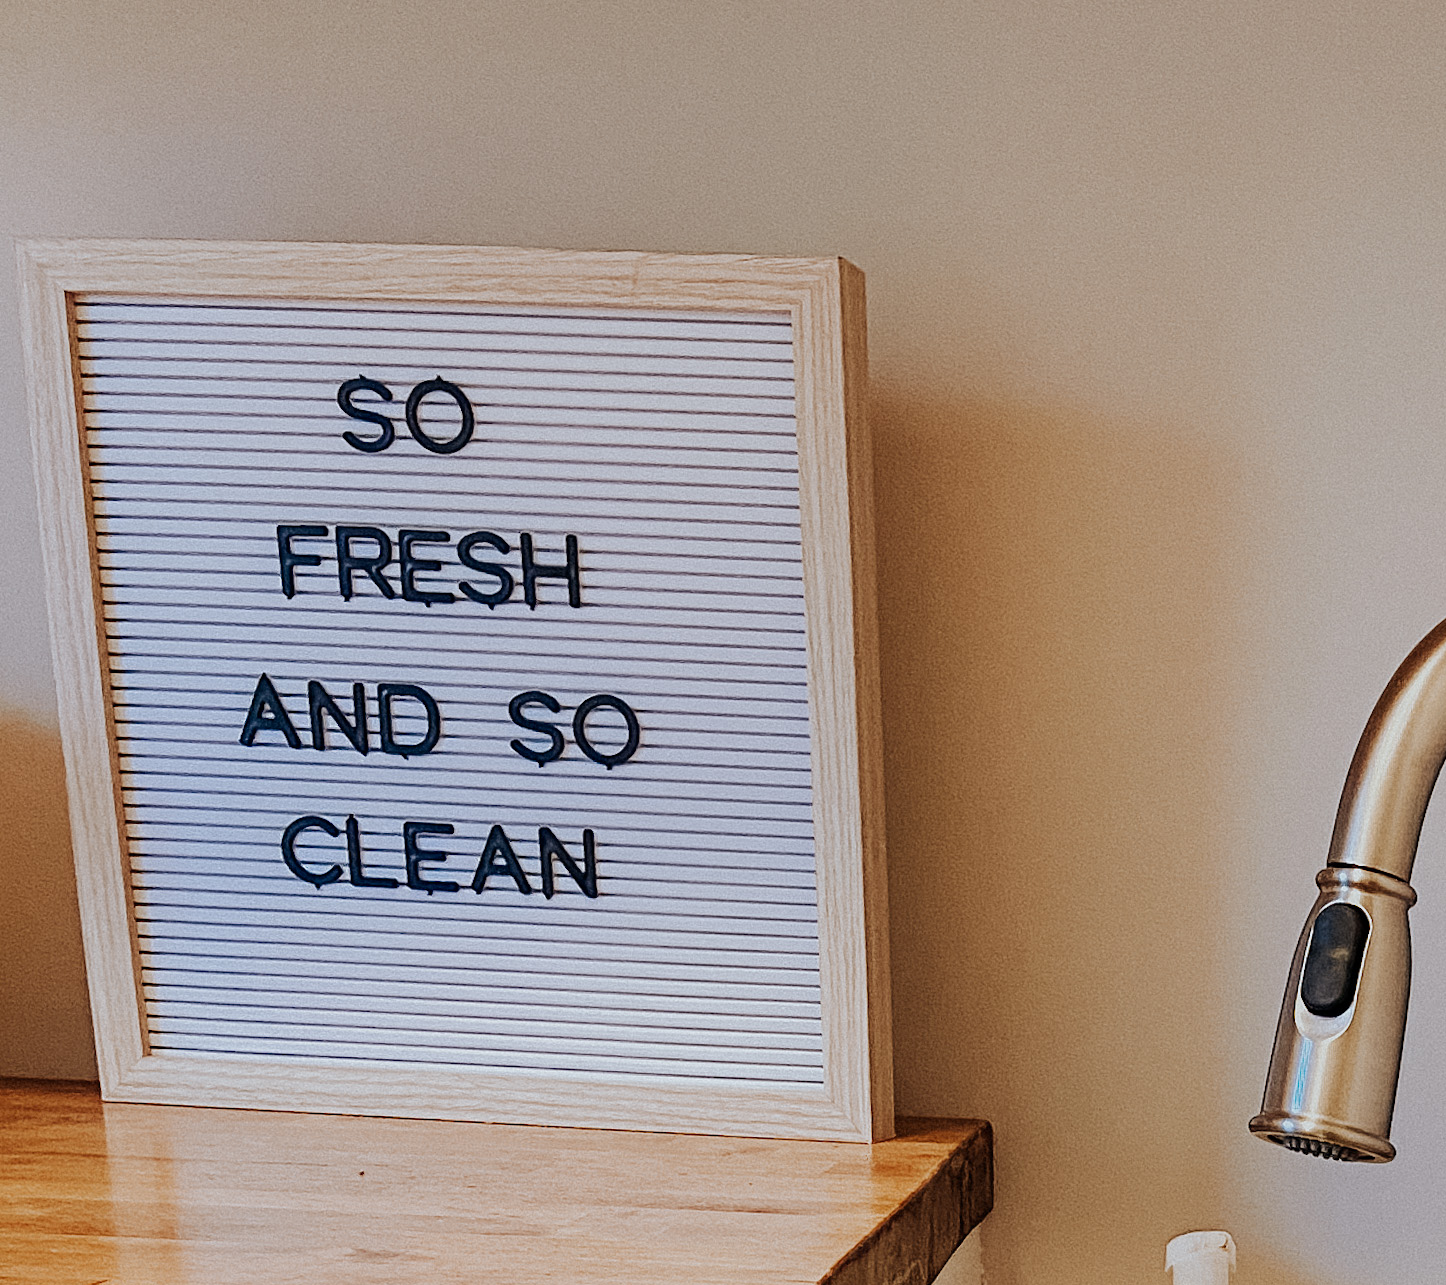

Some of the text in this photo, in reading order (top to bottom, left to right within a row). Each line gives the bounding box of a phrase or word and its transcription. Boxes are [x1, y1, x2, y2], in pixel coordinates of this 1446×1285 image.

[337, 375, 475, 454] SO
[276, 525, 582, 610] FRESH
[239, 673, 641, 770] AND SO
[281, 813, 600, 900] CLEAN
